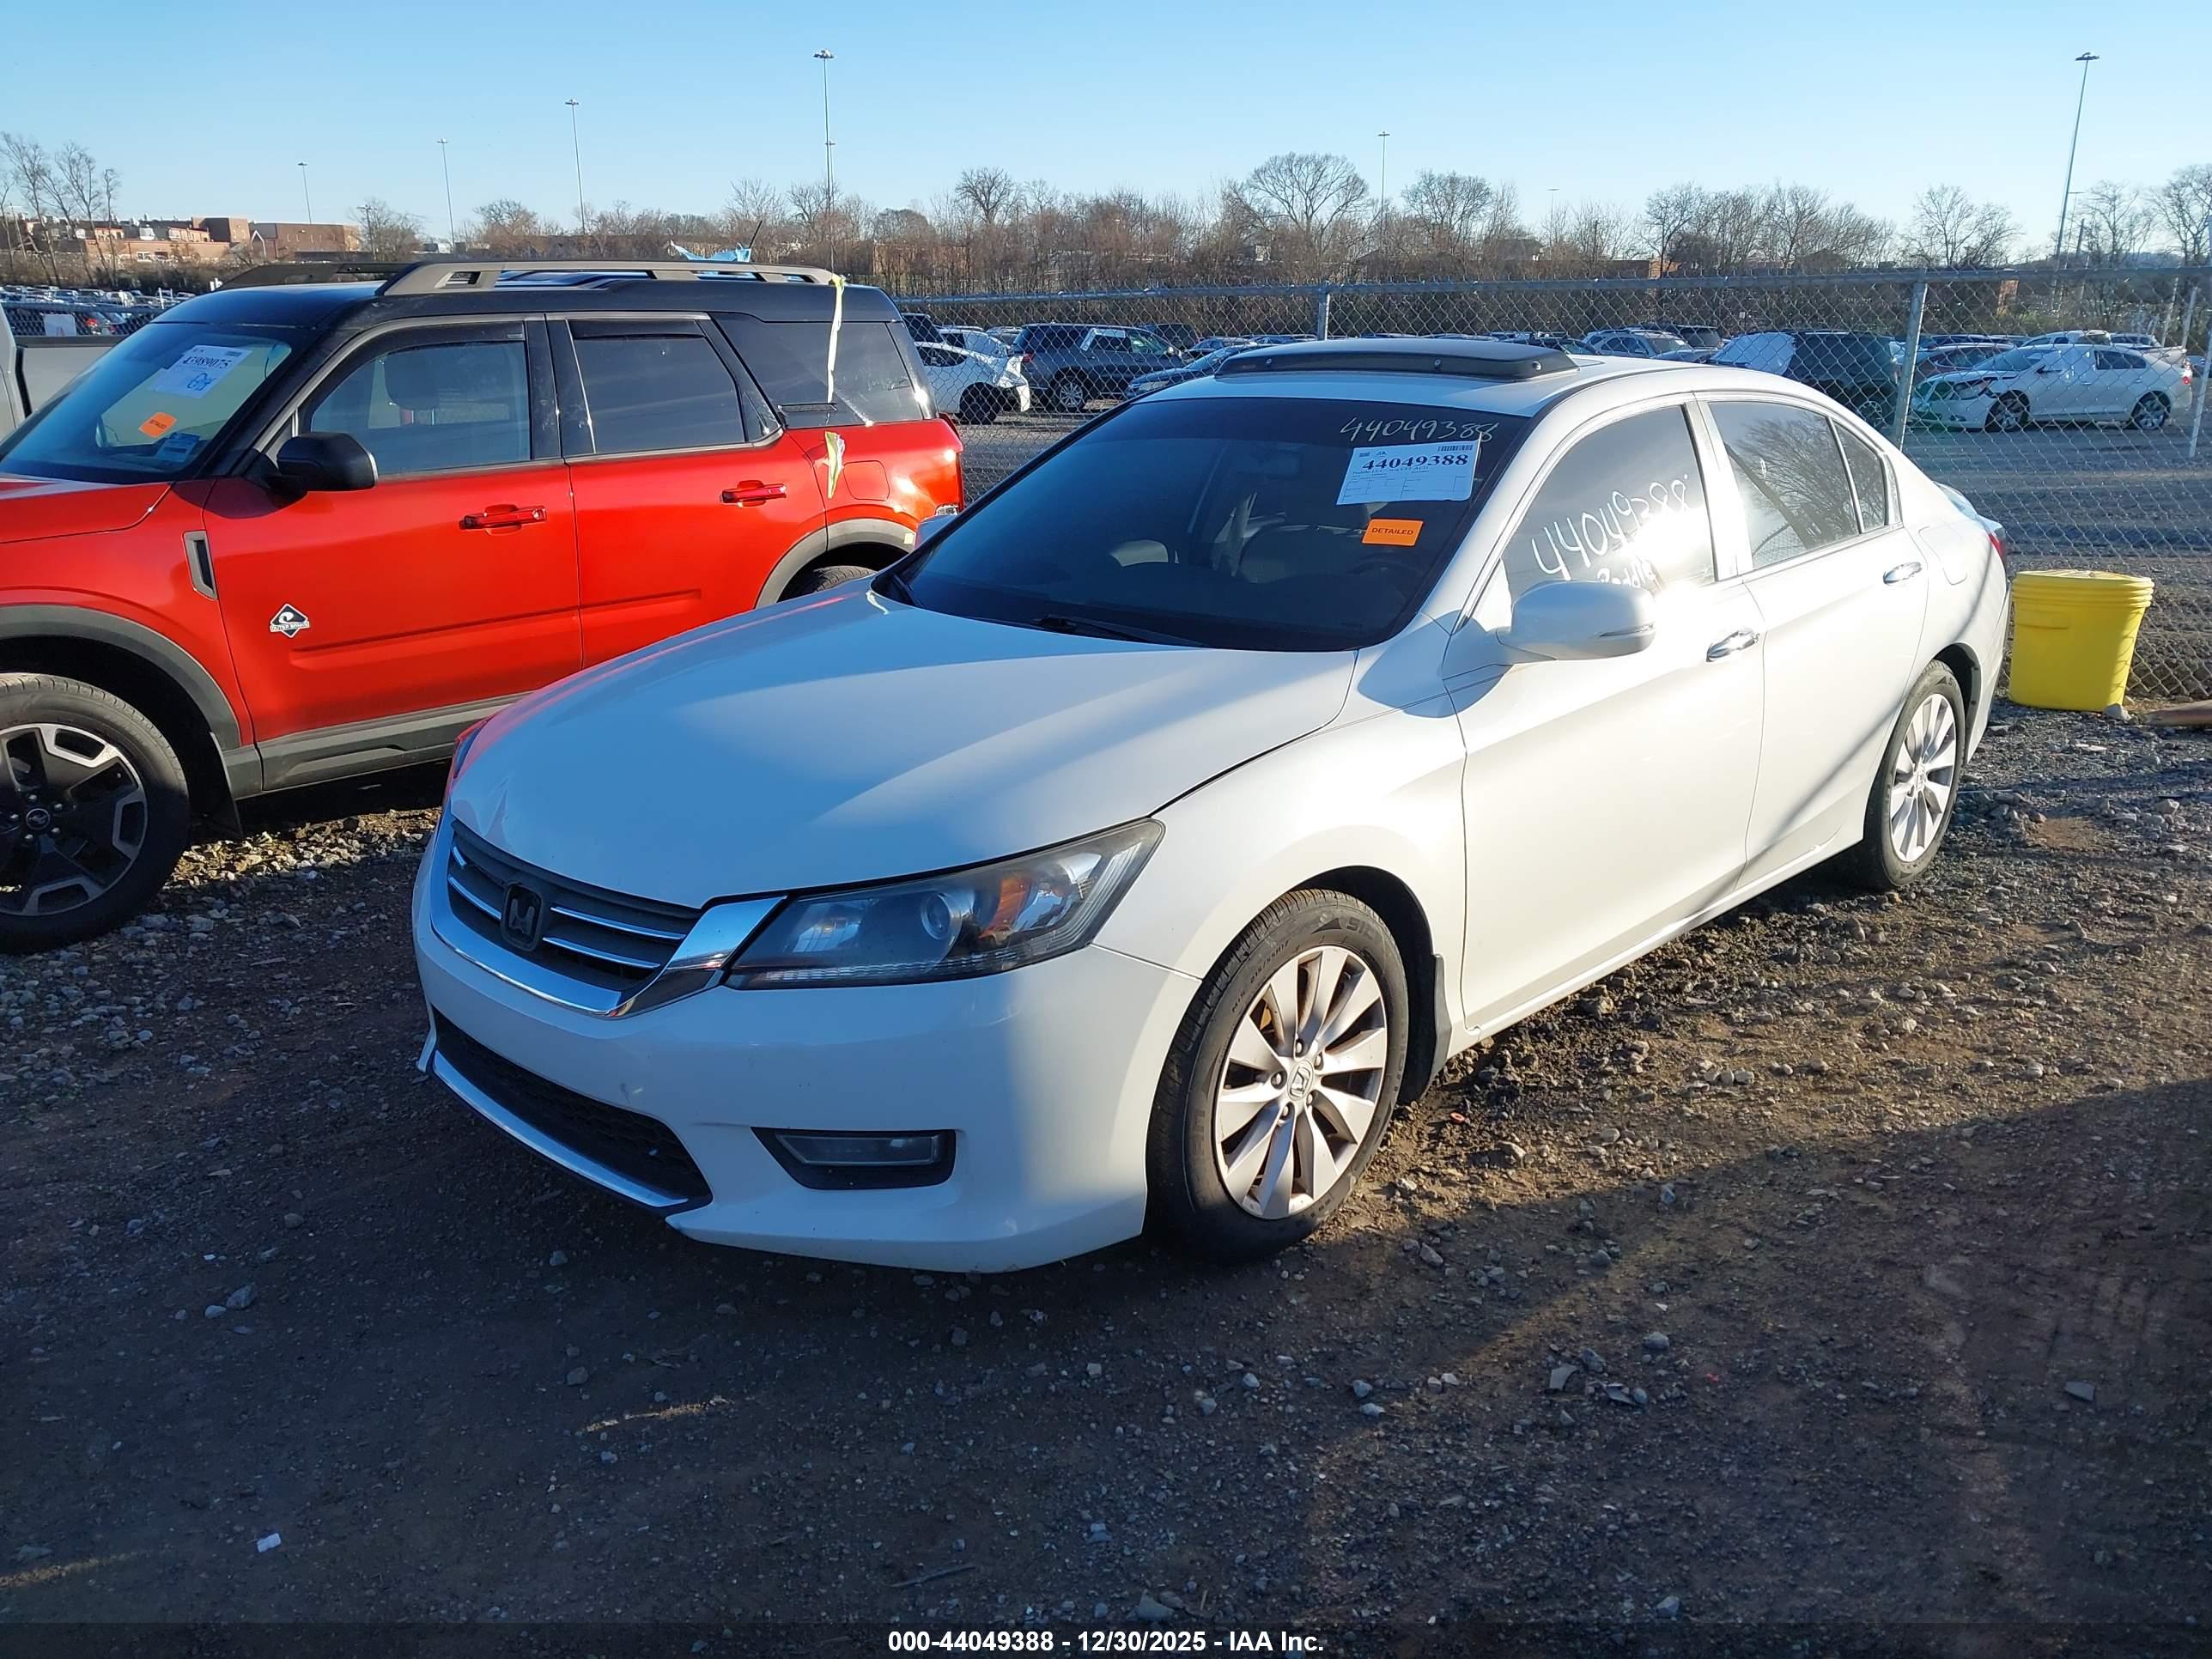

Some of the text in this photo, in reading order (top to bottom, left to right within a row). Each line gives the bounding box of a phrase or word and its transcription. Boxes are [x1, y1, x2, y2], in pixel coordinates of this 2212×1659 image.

[1340, 417, 1499, 442] 44049388
[1362, 453, 1469, 471] 44049388
[1371, 527, 1414, 536] DETAILED
